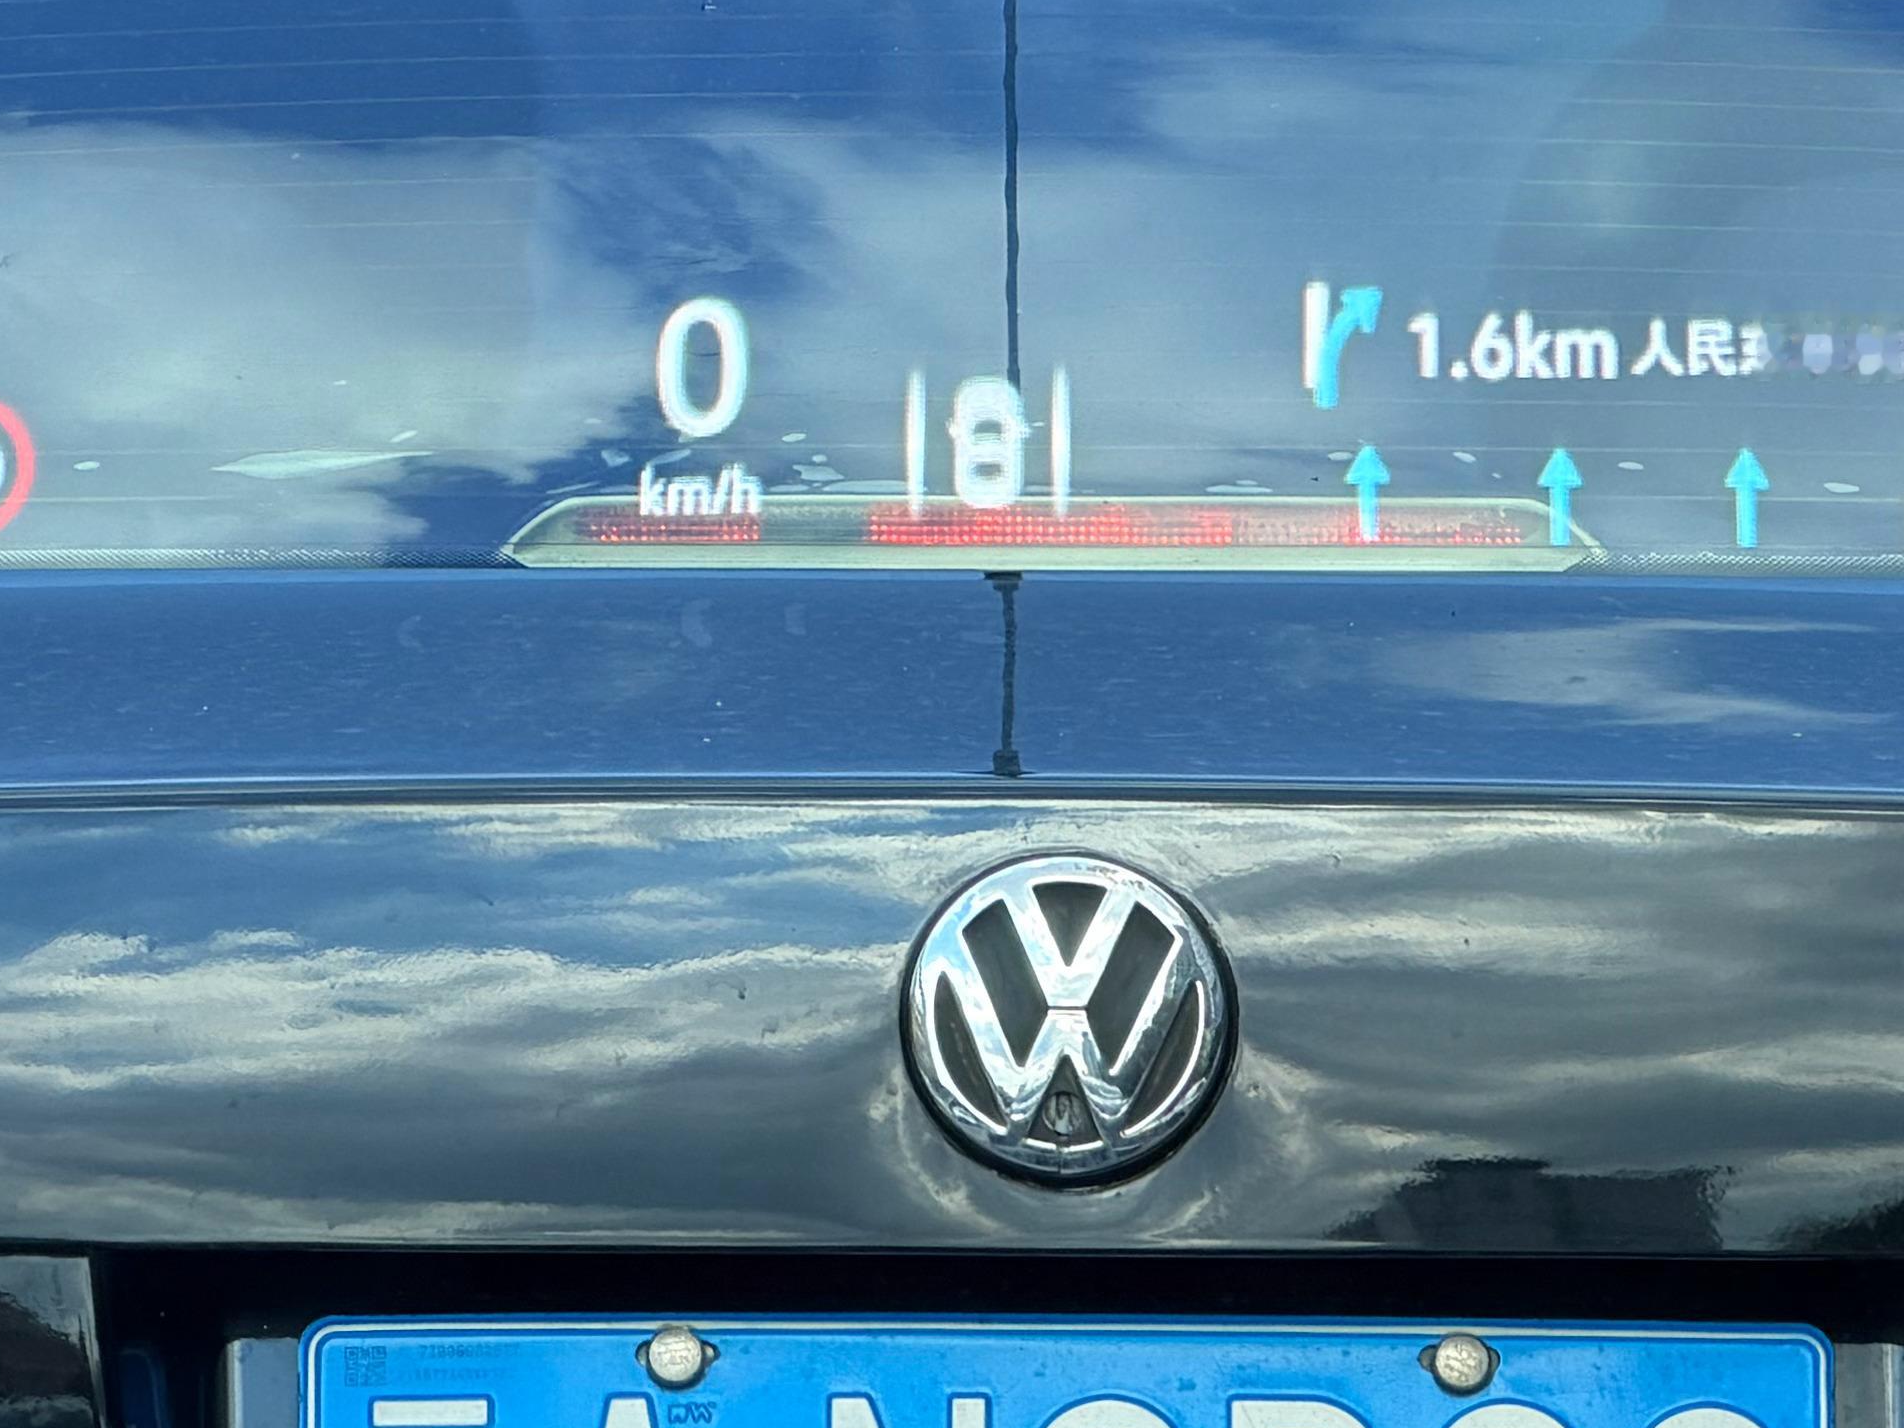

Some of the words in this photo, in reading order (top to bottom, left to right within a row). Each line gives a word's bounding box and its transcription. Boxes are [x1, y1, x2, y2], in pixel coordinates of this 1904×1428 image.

[656, 296, 749, 438] 0
[1407, 311, 1620, 380] 1.6km
[639, 462, 763, 517] km/h
